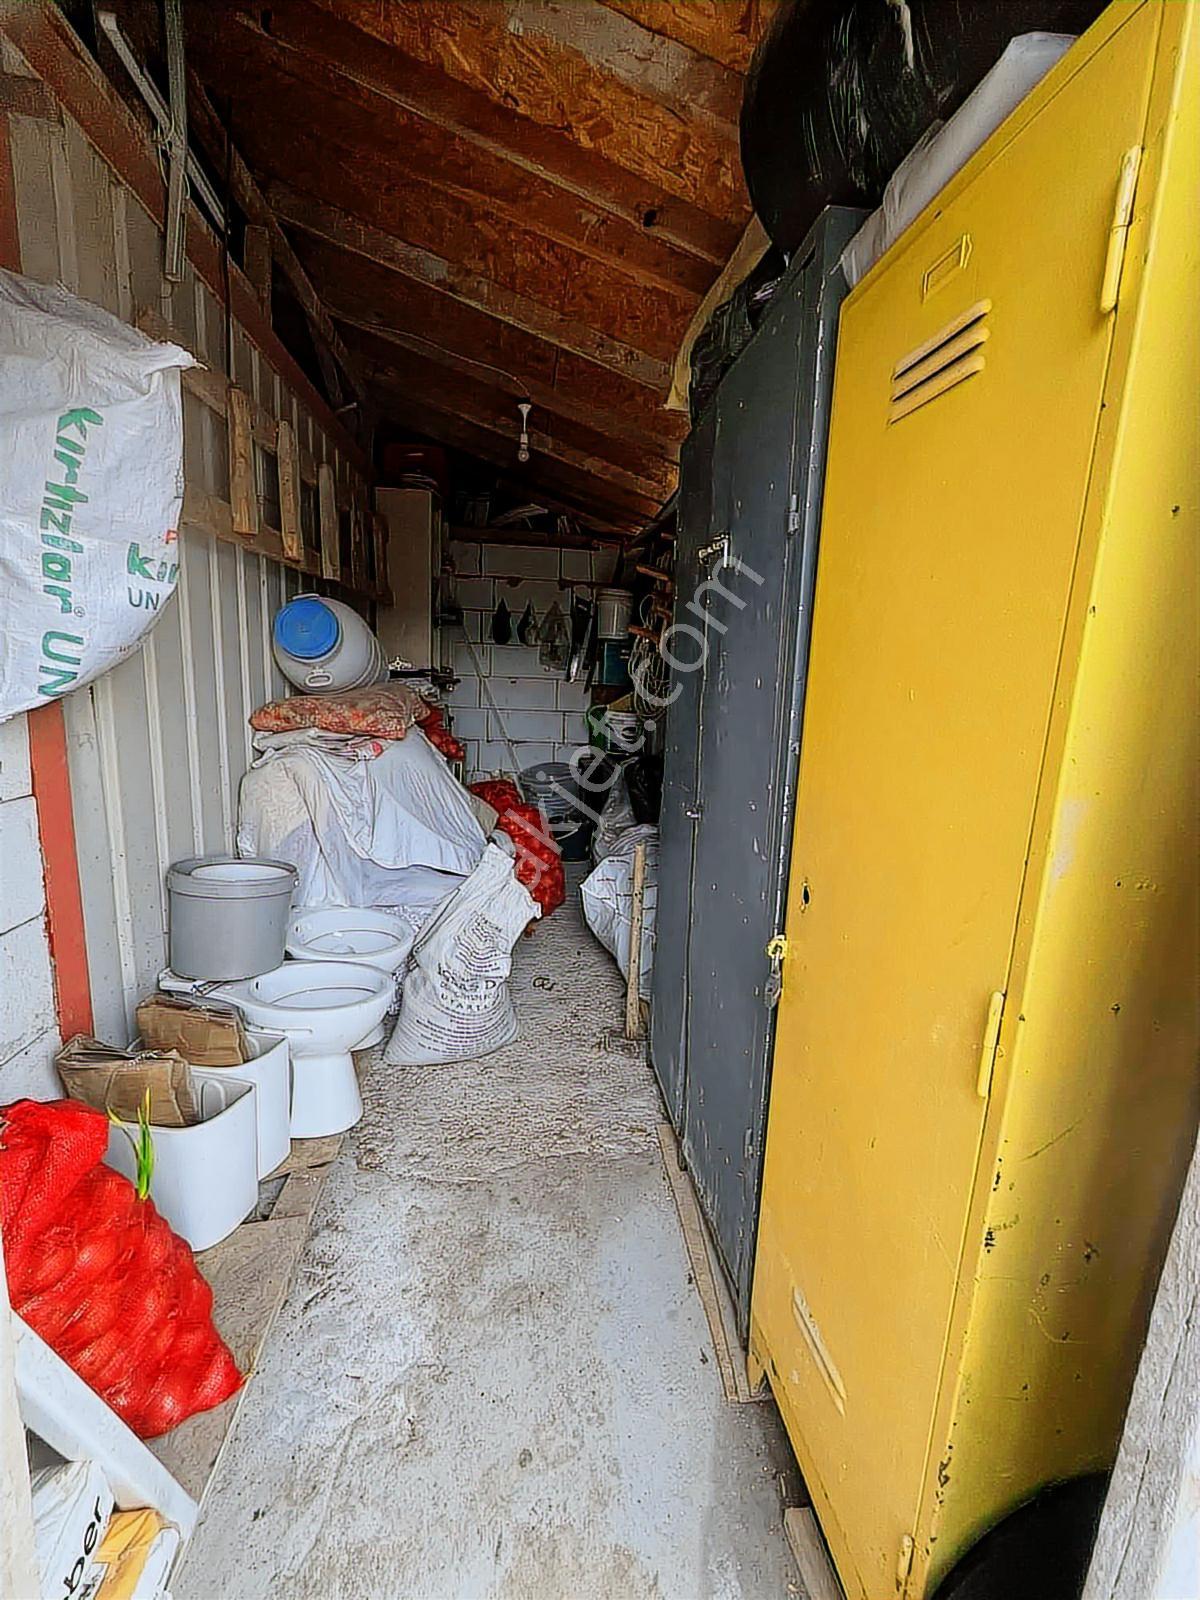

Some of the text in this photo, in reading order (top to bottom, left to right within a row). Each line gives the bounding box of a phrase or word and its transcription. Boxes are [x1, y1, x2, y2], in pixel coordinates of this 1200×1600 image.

[127, 587, 160, 610] UN
[38, 630, 84, 698] UN
[64, 1496, 102, 1600] ber
